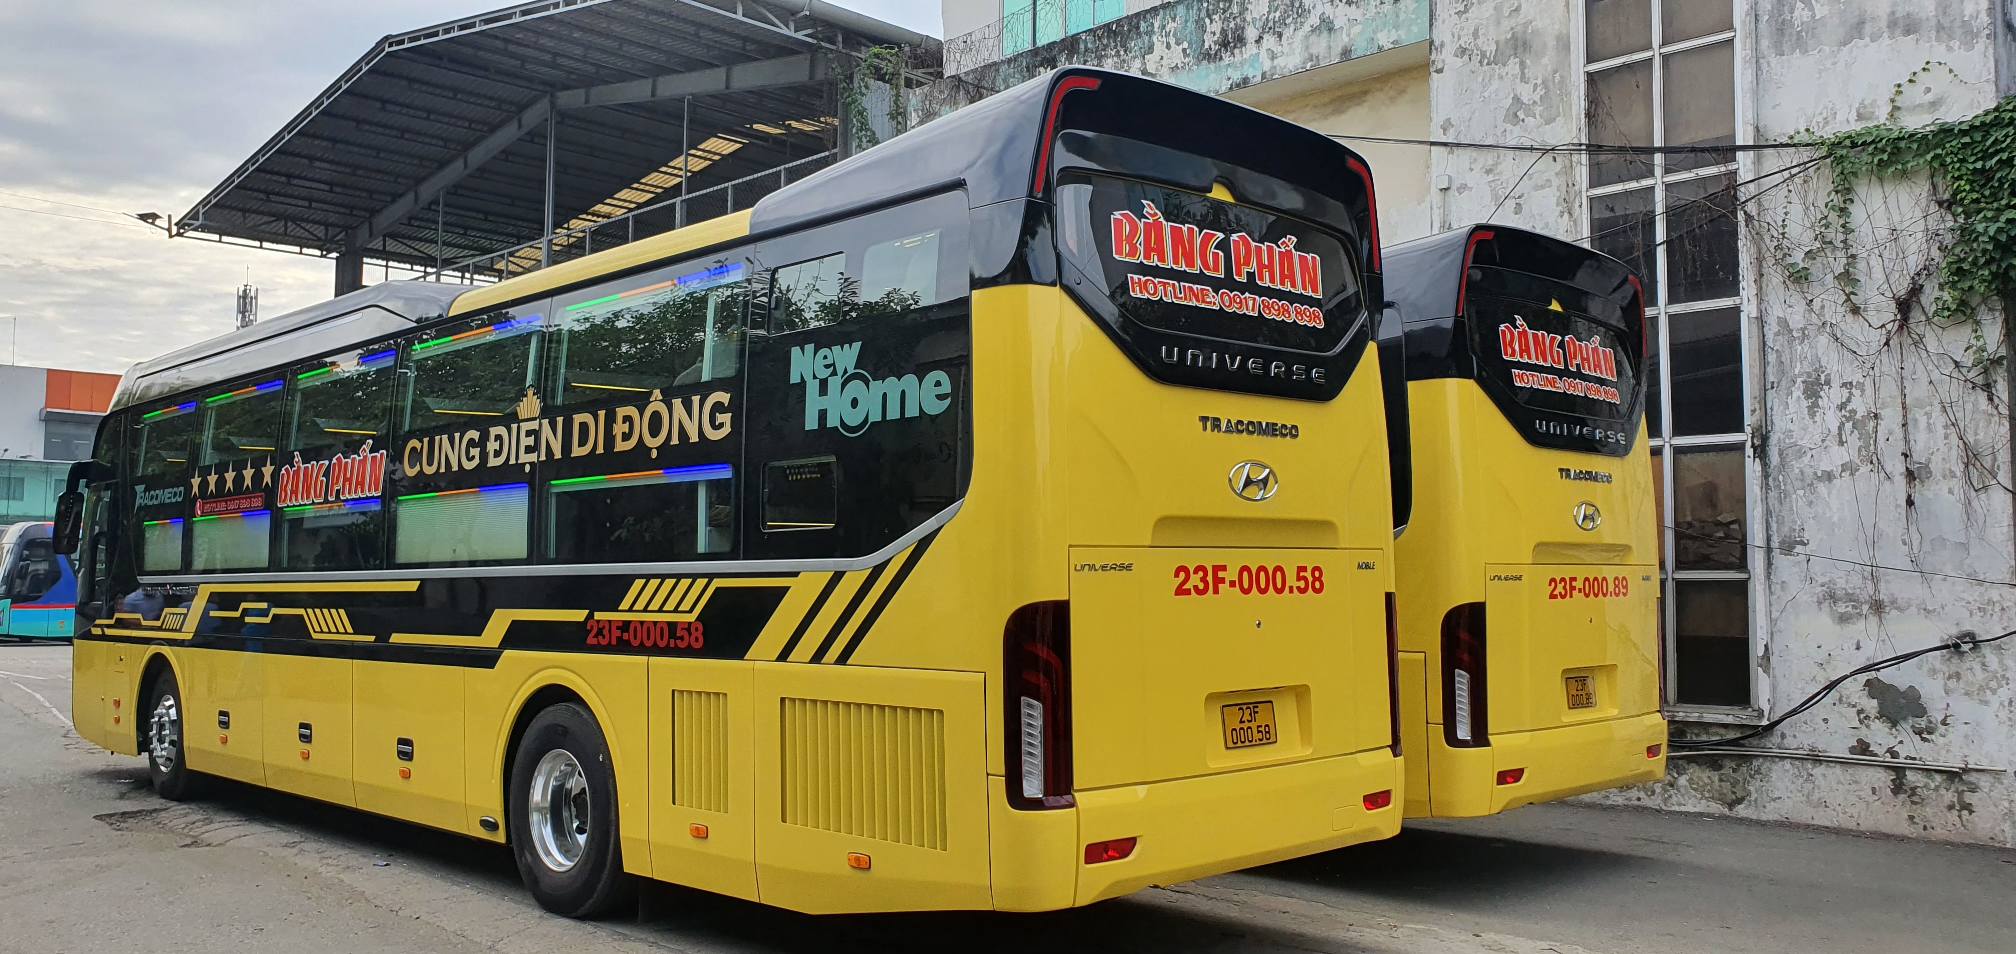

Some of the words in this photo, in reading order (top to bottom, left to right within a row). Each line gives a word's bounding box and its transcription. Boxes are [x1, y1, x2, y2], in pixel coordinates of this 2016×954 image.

[1111, 200, 1224, 278] BẰNG
[1128, 274, 1219, 310] HOTLINE:
[1219, 290, 1258, 316] 0917
[1261, 298, 1294, 322] 898
[1294, 305, 1324, 328] 898
[790, 341, 862, 384] New
[1162, 345, 1326, 384] UNIVERSE
[805, 370, 951, 437] Home
[1562, 377, 1585, 396] 0917
[1585, 382, 1602, 400] 898
[1602, 386, 1620, 404] 898
[403, 430, 481, 477] CUNG
[571, 411, 606, 457] DI
[612, 389, 732, 459] ĐỘNG
[1199, 416, 1299, 439] TRACOMECO
[1536, 419, 1626, 444] UNIVERSE
[134, 484, 184, 514] TRACOMECO
[1074, 563, 1134, 572] UNIVERSE
[1173, 565, 1325, 597] 23F-000.58
[1548, 576, 1629, 599] 23F-000.89
[586, 619, 704, 649] 23F-000.58
[1238, 705, 1259, 724] 23F
[1231, 724, 1271, 745] 000.58
